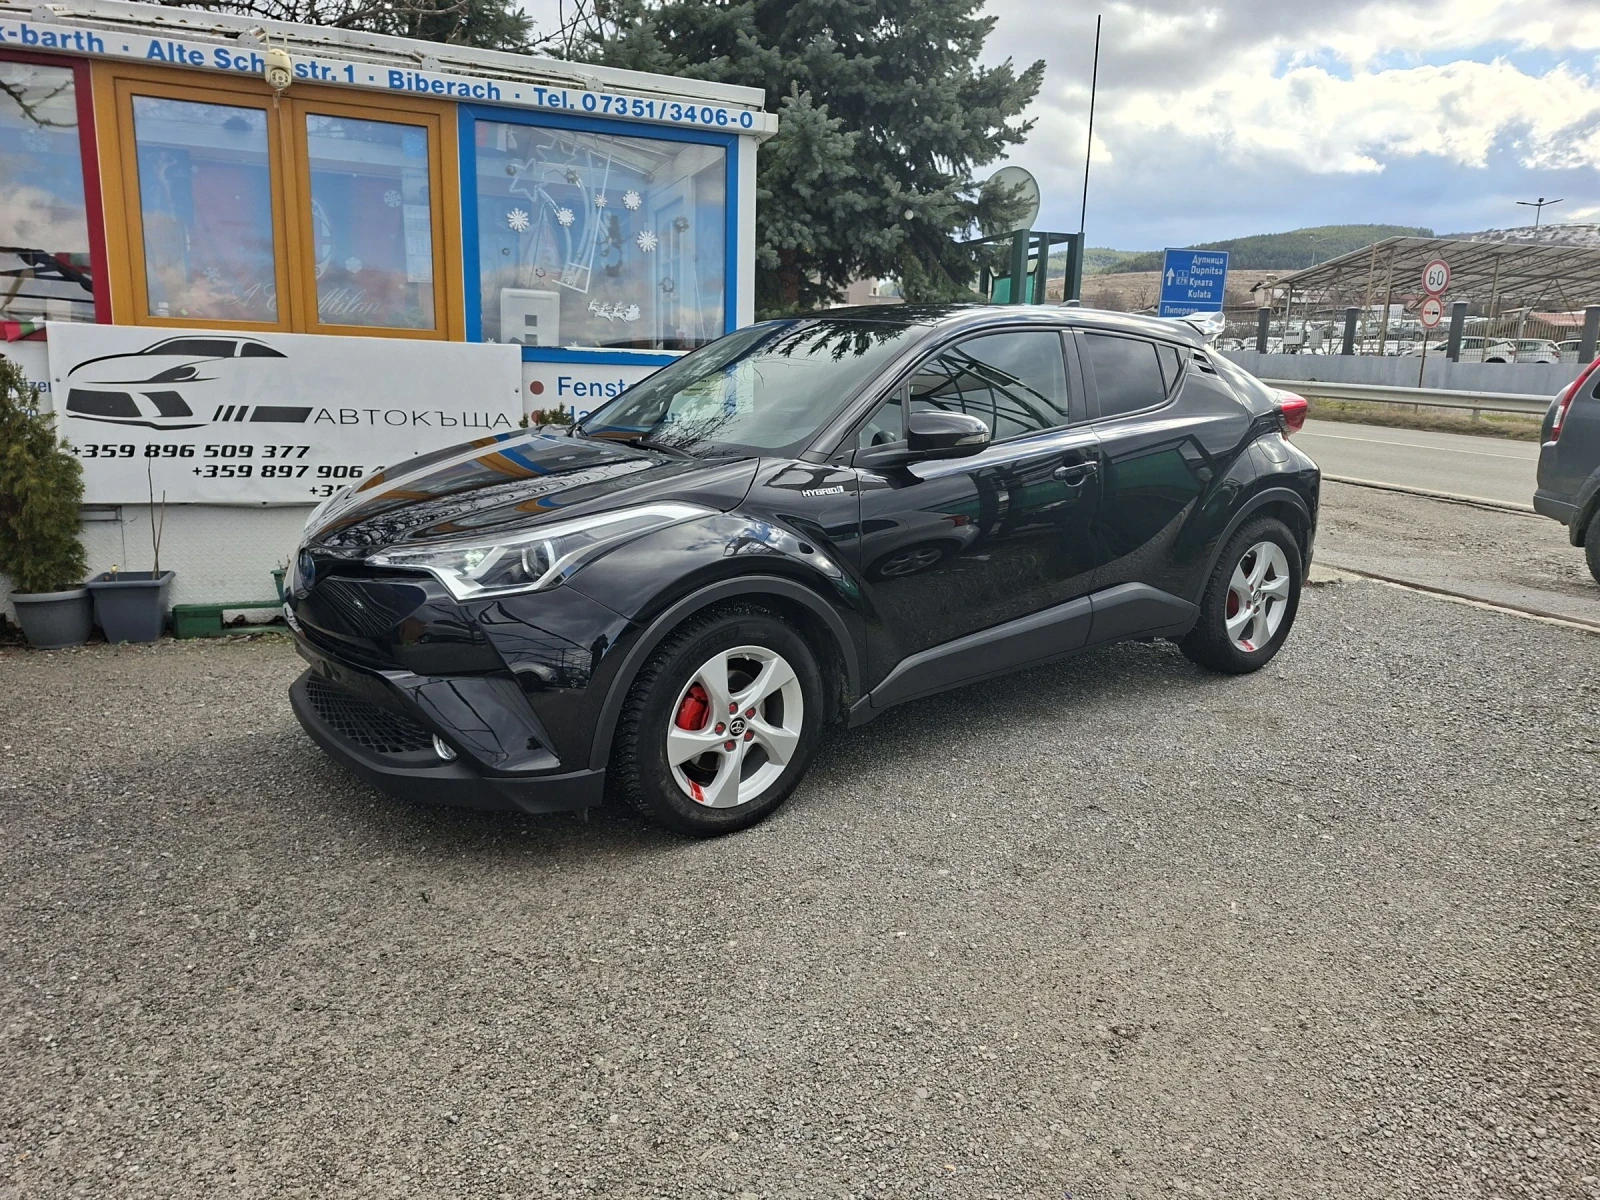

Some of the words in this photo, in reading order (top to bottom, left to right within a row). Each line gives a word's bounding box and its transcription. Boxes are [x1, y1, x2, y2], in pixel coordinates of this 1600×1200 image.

[147, 40, 205, 65] Alte
[213, 48, 337, 82] Schstr.
[343, 65, 354, 83] 1
[388, 70, 501, 100] Biberach
[533, 87, 575, 110] Tel.
[581, 93, 753, 129] 07351/3406-0
[1192, 255, 1224, 265] Дупница
[1190, 266, 1223, 276] Dupnitsa
[1428, 270, 1444, 286] 60
[1189, 277, 1213, 287] Кулата
[1187, 289, 1212, 299] Kulata
[318, 287, 381, 316] Milan
[313, 408, 512, 430] АВТОКЪЩА
[71, 444, 136, 458] +359
[143, 444, 195, 458] 896
[203, 444, 253, 458] 509
[261, 445, 310, 459] 377
[192, 464, 253, 478] +359
[260, 465, 310, 478] 897
[316, 465, 363, 478] 906
[802, 487, 838, 497] HYBRID
